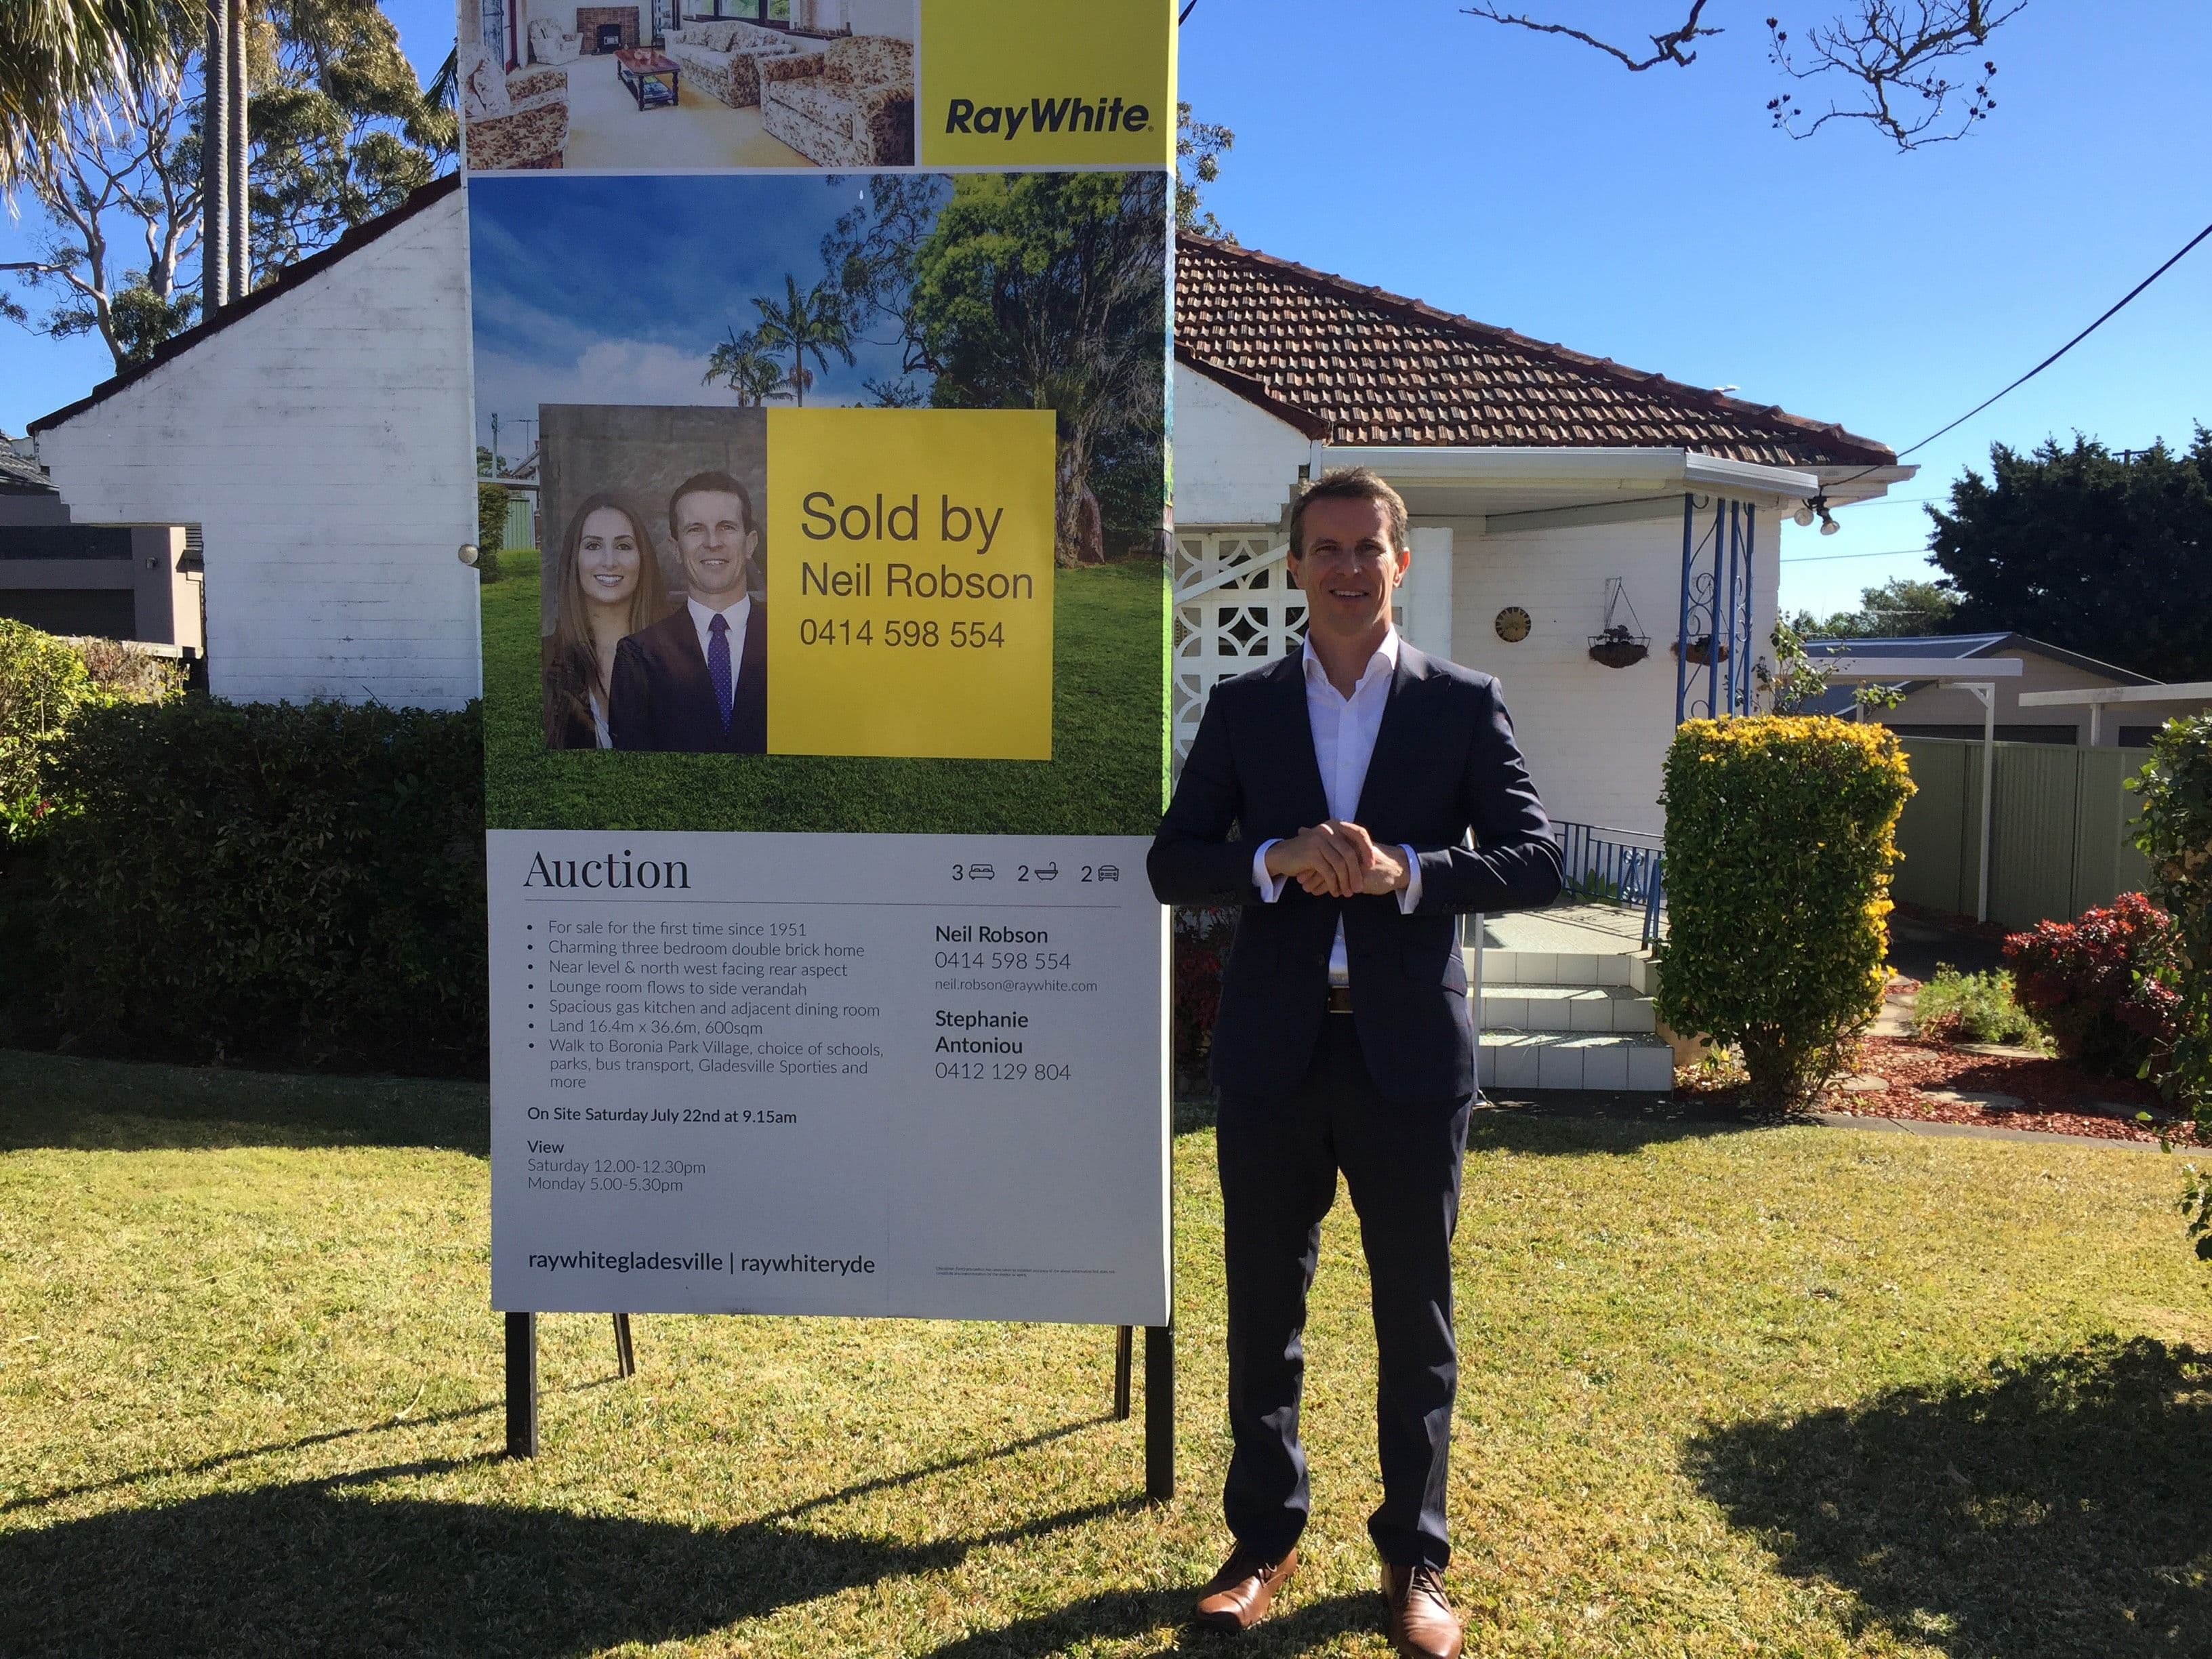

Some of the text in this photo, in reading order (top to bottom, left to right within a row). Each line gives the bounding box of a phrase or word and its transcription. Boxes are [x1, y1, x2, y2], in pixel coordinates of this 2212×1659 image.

[801, 491, 1004, 555] Sold by
[802, 561, 1033, 600] Neil Robson
[800, 618, 1005, 649] 0414 598 554
[523, 849, 691, 889] Auction
[951, 863, 1092, 882] 3 2 2
[548, 920, 806, 937] For sale for the first time since 1951
[936, 925, 1048, 943] Neil Robson
[548, 939, 865, 958] Charming three bedroom double brick home
[549, 959, 848, 979] Near level & north west facing rear aspect
[935, 951, 1071, 970] 0414 598 554
[550, 979, 807, 997] Lounge room flows to side verandah
[935, 977, 1098, 994] neil.robson@raywhite.com
[549, 998, 880, 1019] Spacious gas kitchen and adjacent dining room
[550, 1019, 763, 1038] Land 16.4m x 36.6m, 600sqm
[935, 1010, 1029, 1031] Stephanie
[548, 1038, 884, 1058] Walk to Boronia Park Village, choice of schools,
[935, 1036, 1023, 1054] Antoniou
[550, 1057, 868, 1076] parks, bus transport, Gladesville Sporties and
[935, 1061, 1071, 1081] 0412 129 804
[550, 1078, 586, 1089] more
[527, 1107, 797, 1125] On Site Saturday July 22nd at 9.15am
[527, 1140, 565, 1154] View
[527, 1158, 706, 1176] Saturday 12.00-12.30pm
[528, 1176, 683, 1194] Monday 5.00-5.30pm
[529, 1250, 723, 1273] raywhitegladesville
[741, 1253, 876, 1277] raywhiteryde
